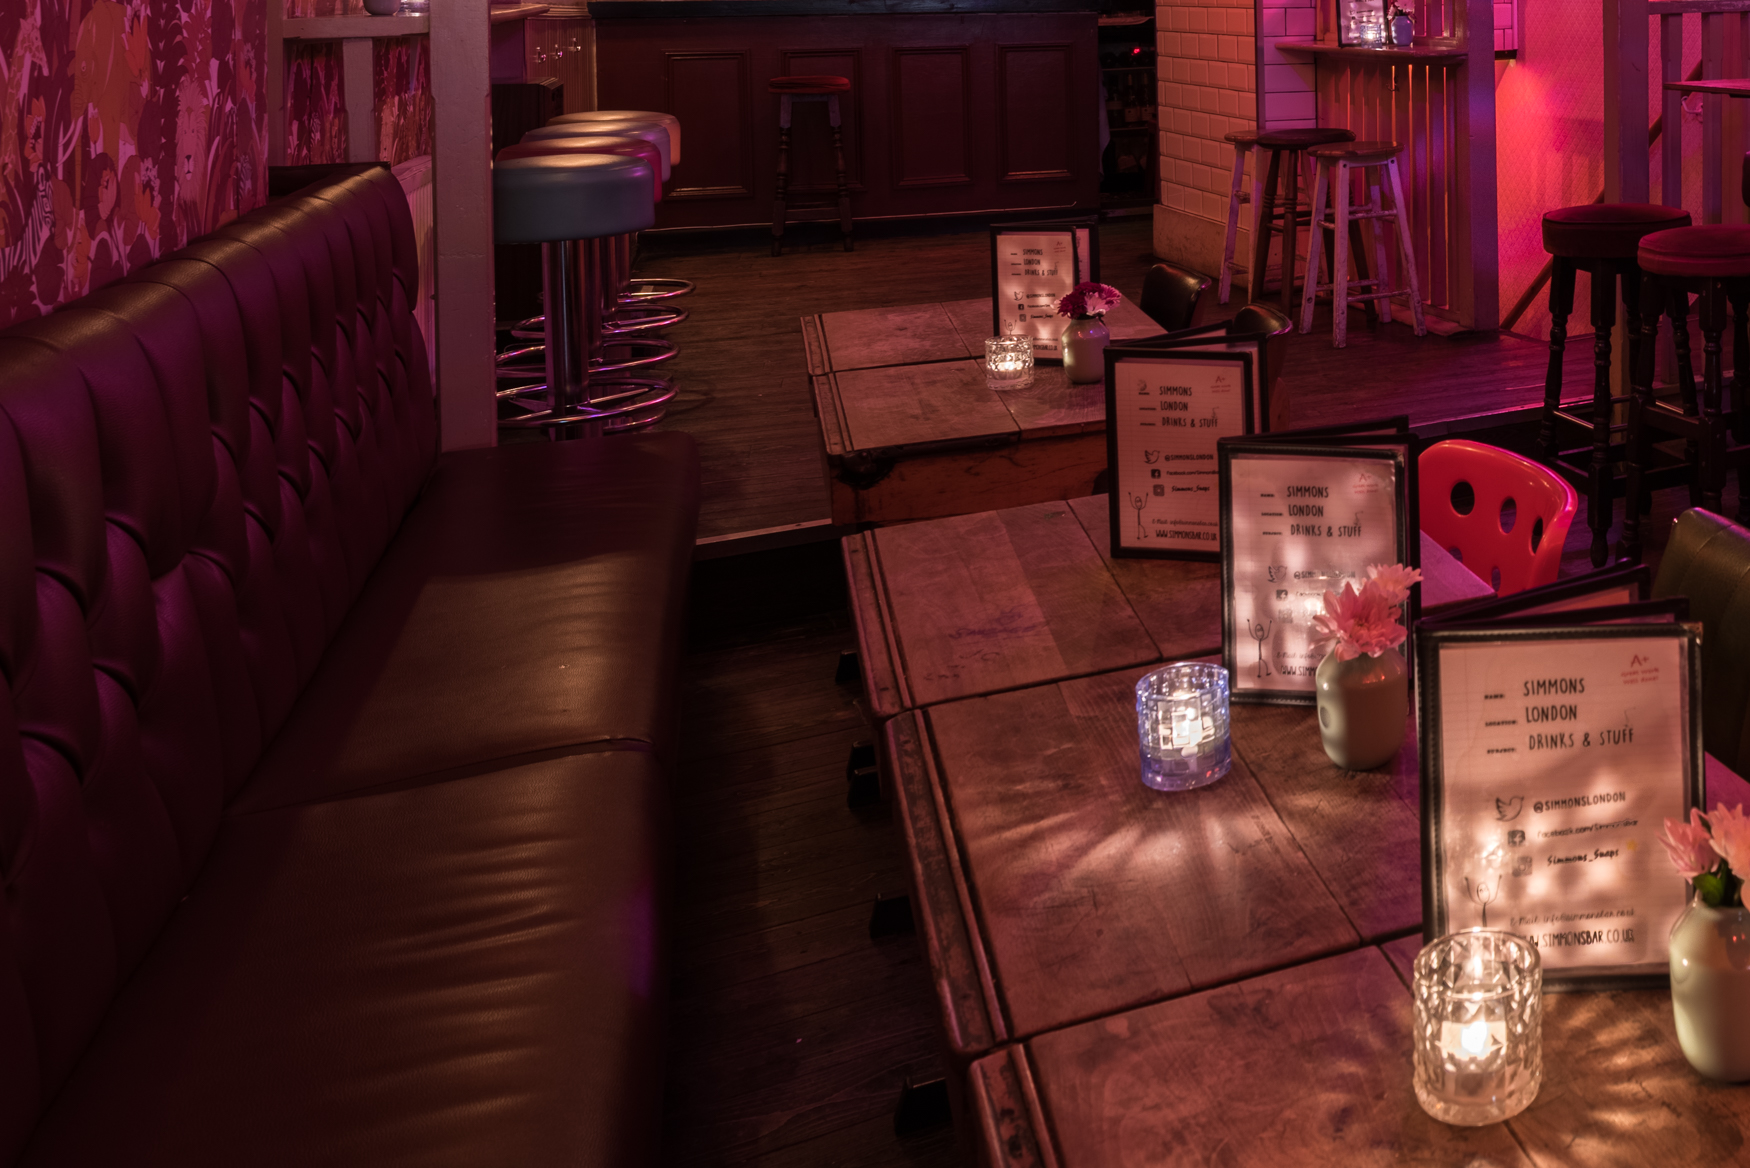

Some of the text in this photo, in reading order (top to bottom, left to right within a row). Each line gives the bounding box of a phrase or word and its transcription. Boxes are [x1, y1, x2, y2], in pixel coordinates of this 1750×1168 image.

[1159, 385, 1192, 396] SIMMONS
[1160, 401, 1188, 411] LONDON
[1162, 417, 1218, 427] DRINKS & STUFF
[1287, 486, 1329, 498] SIMMONS
[1288, 504, 1324, 517] LONDON
[1291, 524, 1361, 537] DRINKS & STUFF
[1523, 678, 1585, 697] SIMMONS
[1526, 705, 1577, 723] LONDON
[1529, 732, 1574, 750] DRINKS
[1583, 733, 1590, 747] &
[1600, 728, 1634, 746] STUFF
[1533, 791, 1625, 813] @SIMMONSLONDON
